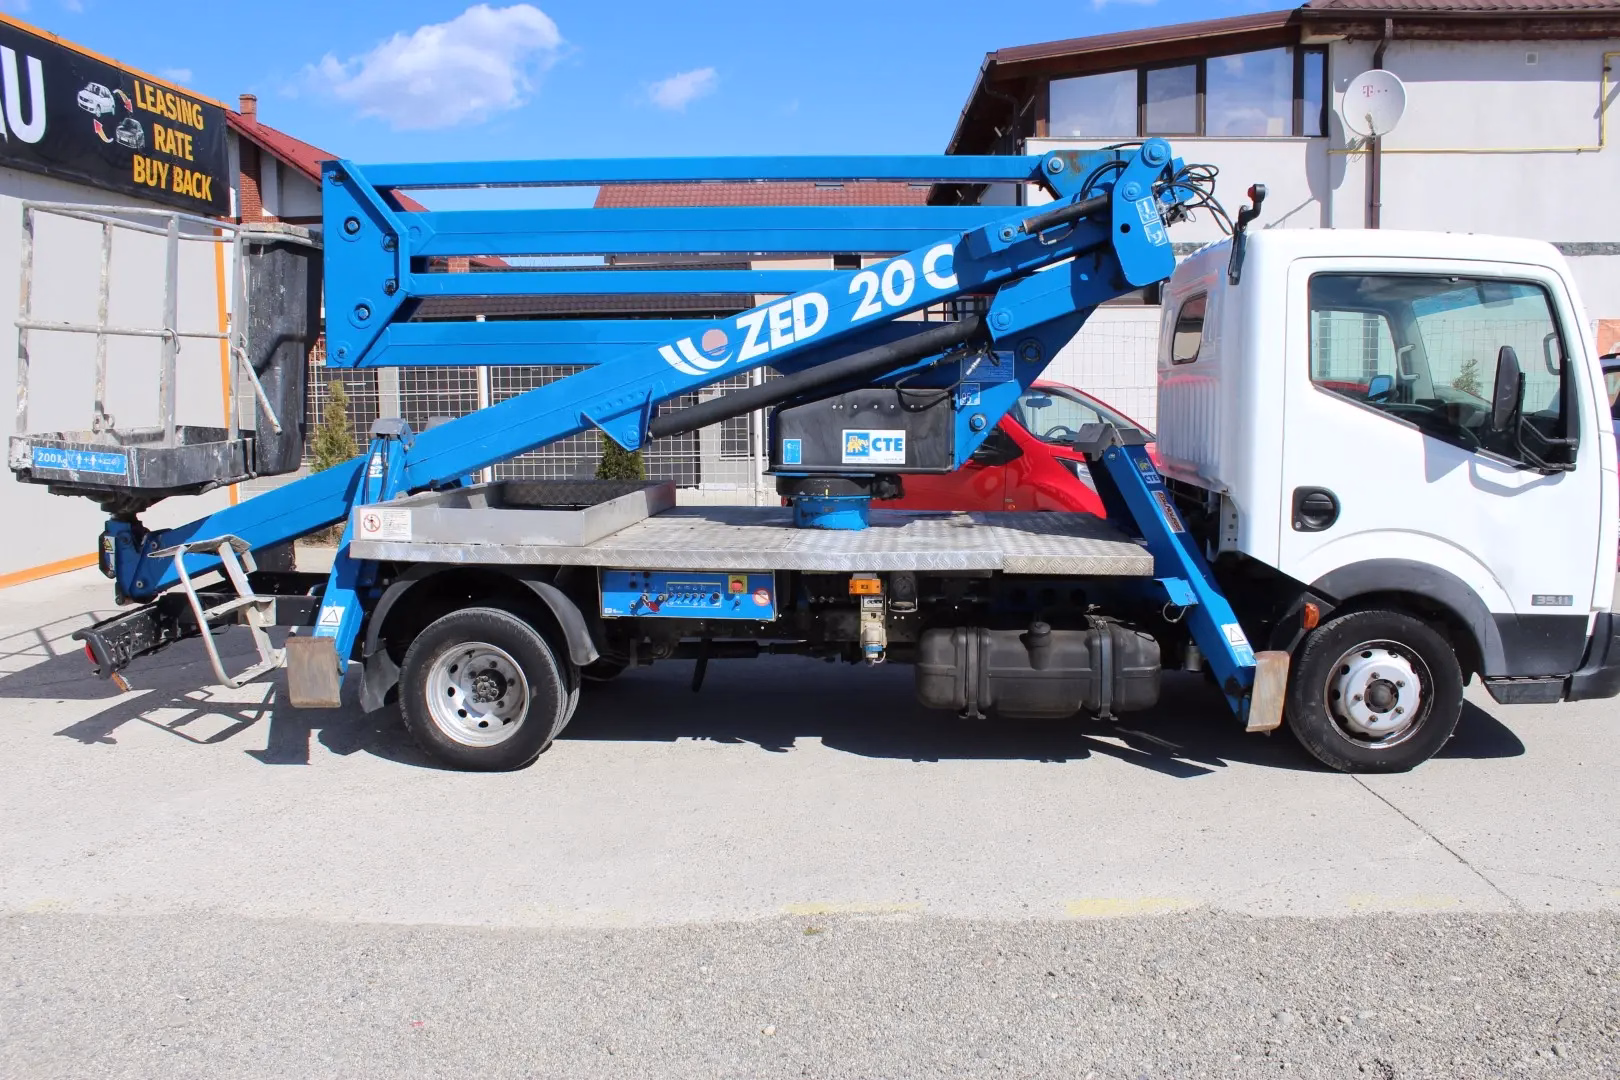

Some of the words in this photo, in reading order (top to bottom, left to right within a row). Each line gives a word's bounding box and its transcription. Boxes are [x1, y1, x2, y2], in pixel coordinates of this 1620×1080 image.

[0, 44, 47, 144] U
[134, 80, 204, 130] LEASING
[153, 123, 194, 161] RATE
[133, 154, 168, 189] BUY
[172, 165, 212, 201] BACK
[736, 292, 829, 362] ZED
[849, 259, 915, 322] 20
[871, 437, 903, 452] CTE
[1144, 474, 1159, 482] CTE
[1536, 595, 1569, 605] 35.11
